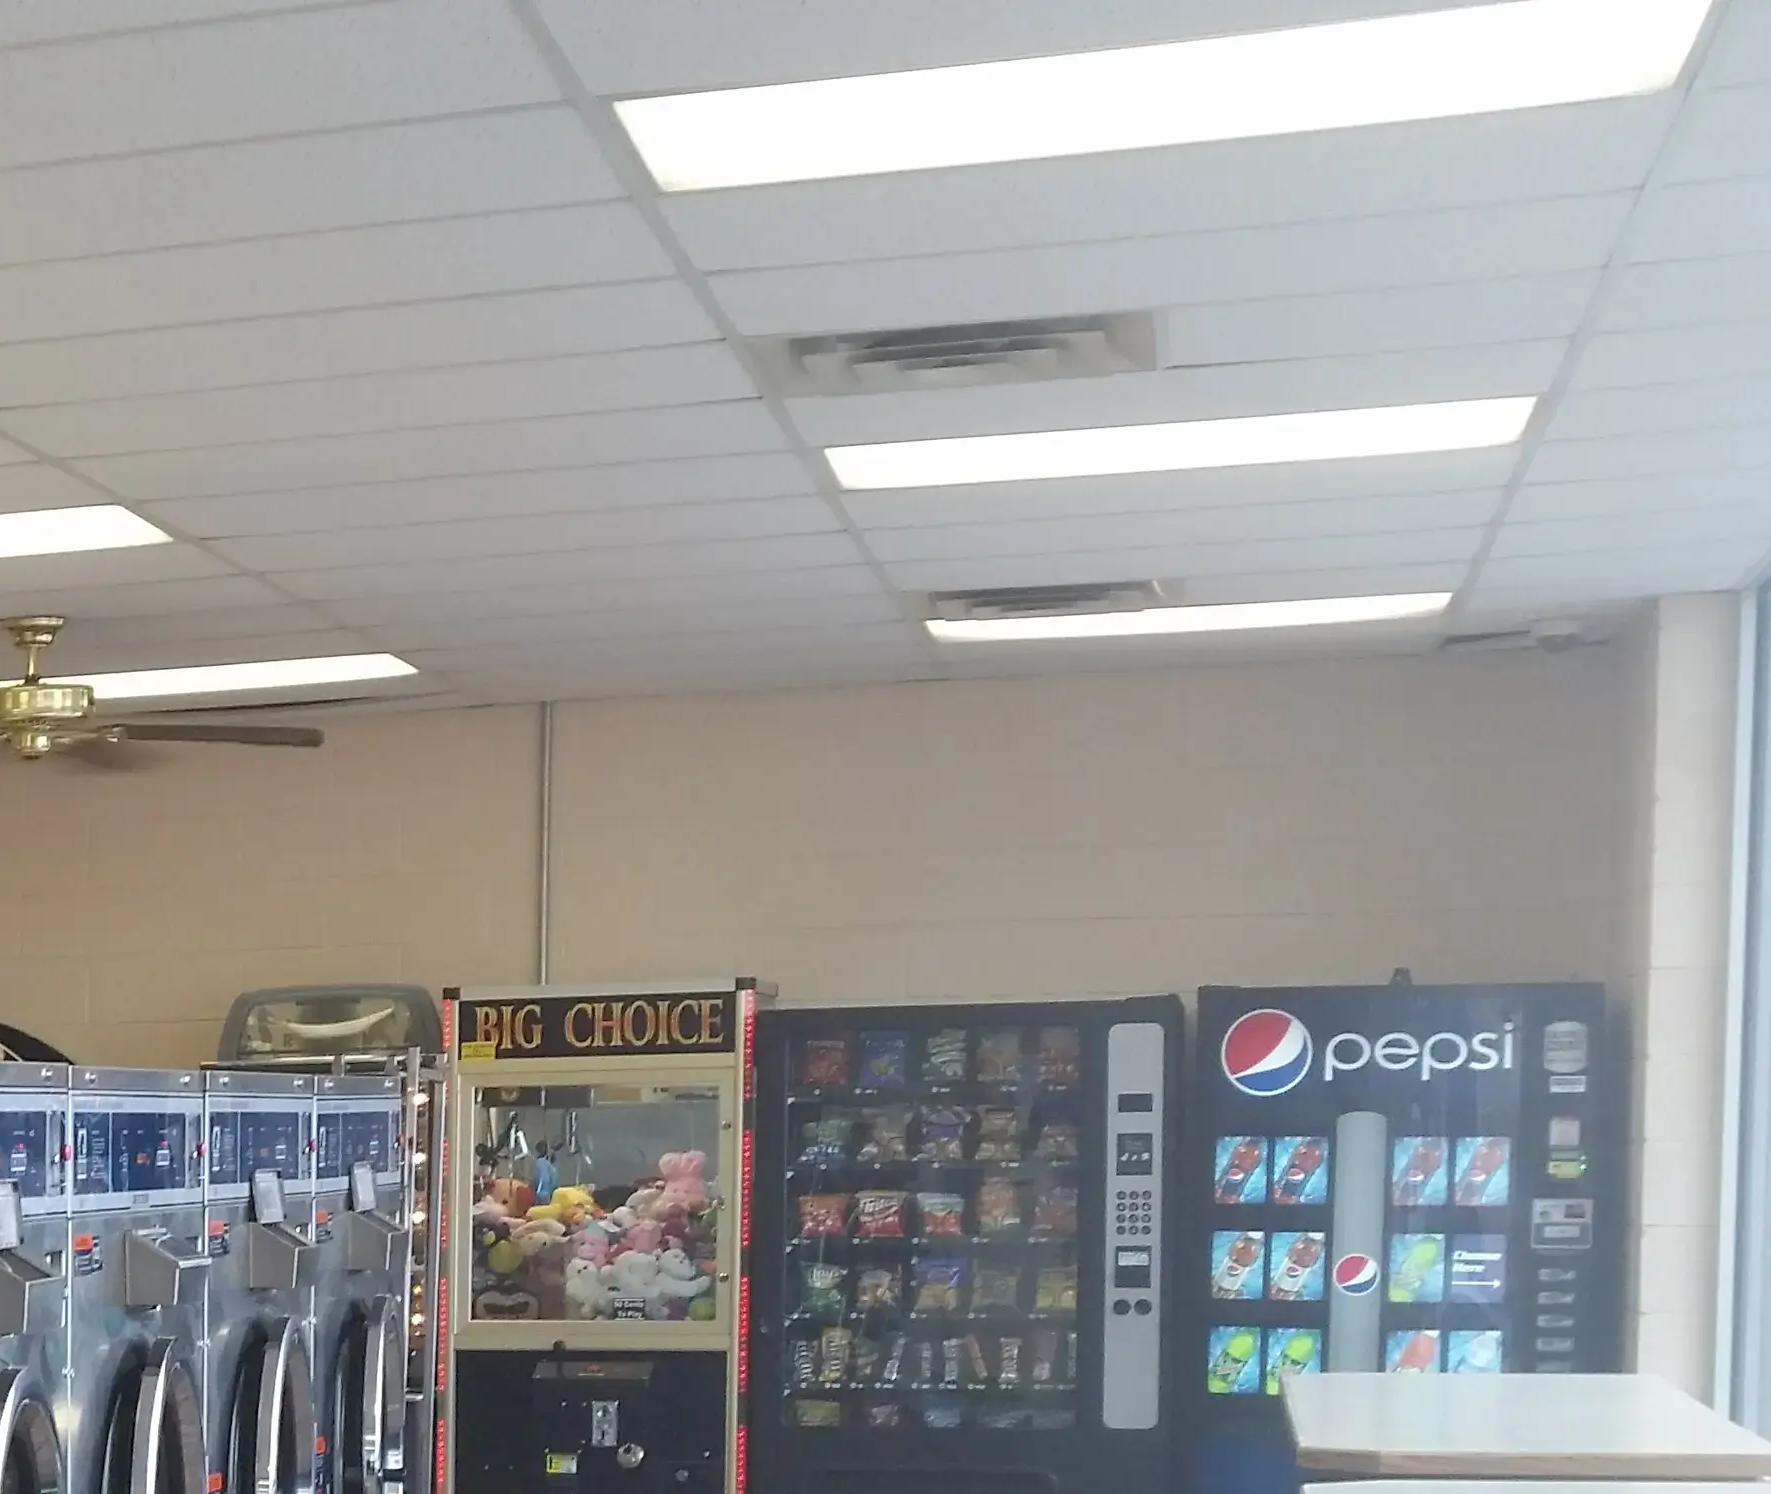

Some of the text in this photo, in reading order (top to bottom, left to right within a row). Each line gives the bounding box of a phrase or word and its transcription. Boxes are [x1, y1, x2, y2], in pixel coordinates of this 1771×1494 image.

[475, 999, 725, 1049] BIG CHOICE
[1324, 1022, 1514, 1081] pepsi
